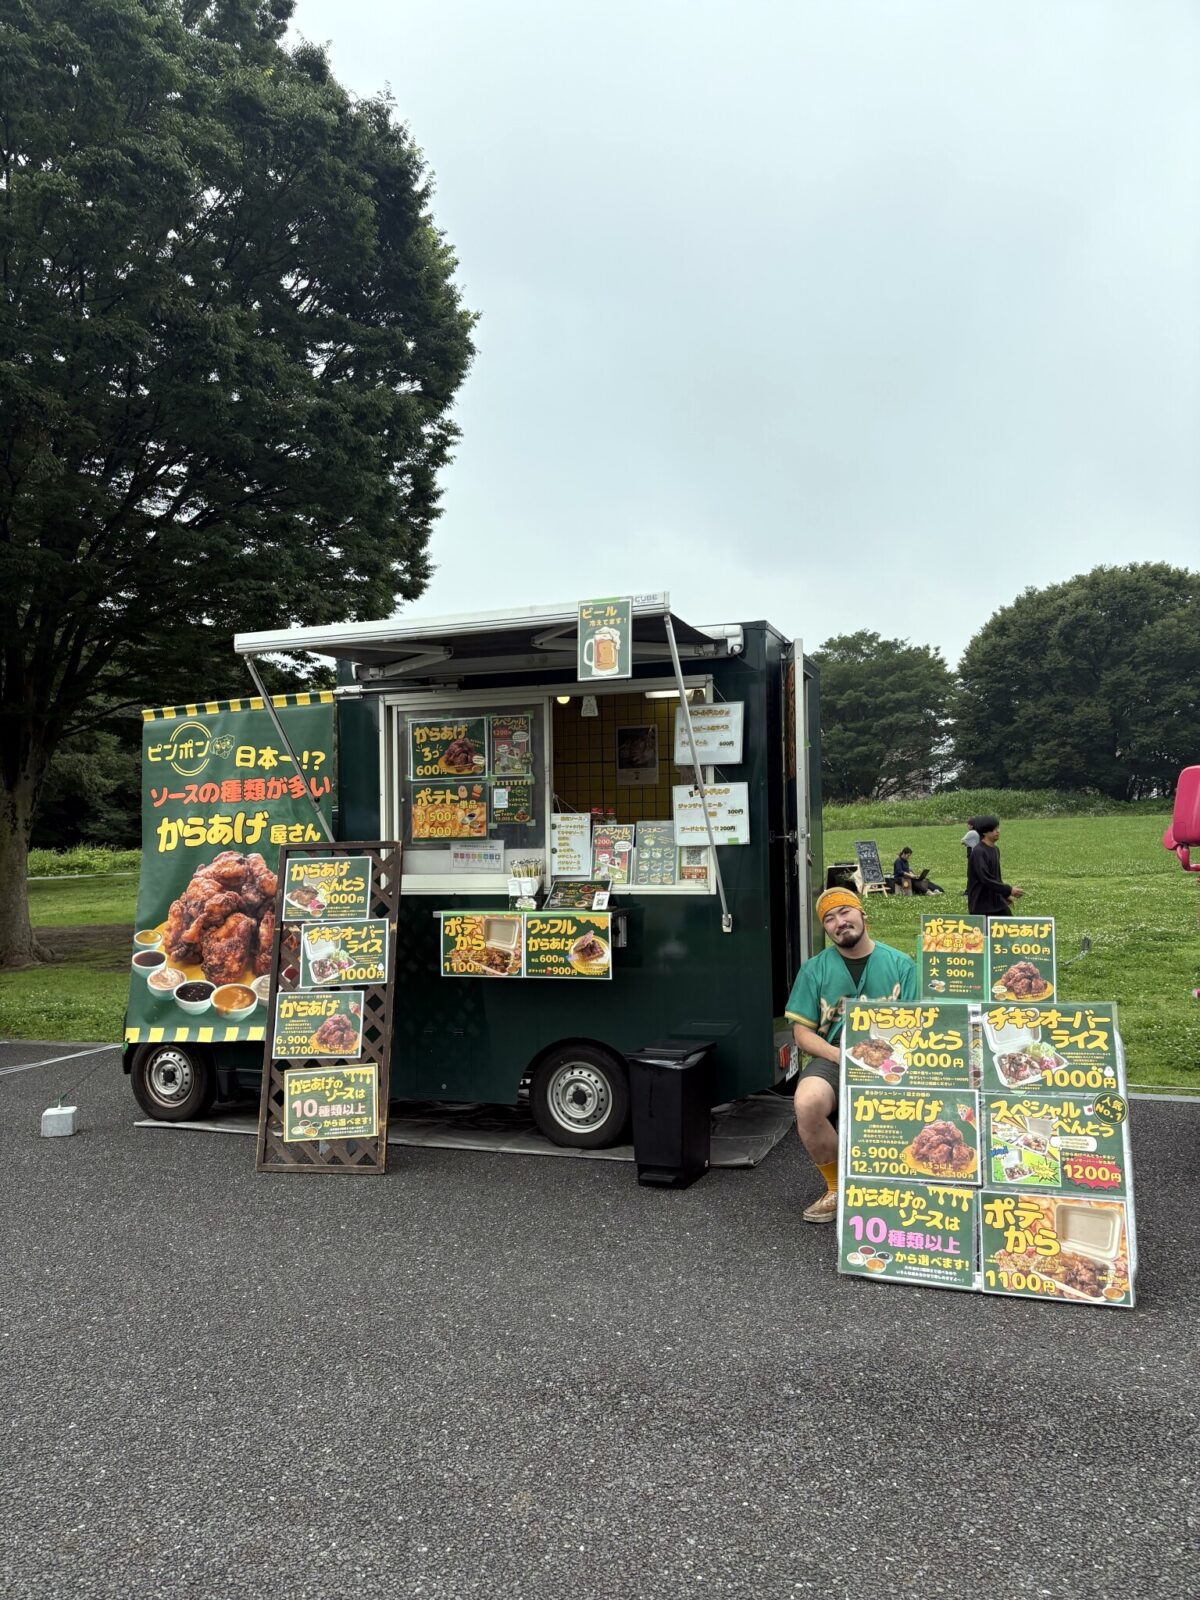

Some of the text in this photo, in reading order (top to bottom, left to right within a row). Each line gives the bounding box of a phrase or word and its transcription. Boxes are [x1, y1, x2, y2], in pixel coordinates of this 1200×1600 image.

[582, 606, 617, 619] ビール
[414, 724, 468, 744] からあげ
[148, 739, 210, 761] ピンポン
[235, 746, 326, 770] 日本一!?
[416, 765, 447, 776] 600円
[150, 774, 331, 807] ソースの種類が多い
[415, 787, 459, 806] ポテト
[459, 800, 478, 810] 単品
[430, 811, 457, 822] 500円
[430, 827, 458, 836] 900円
[594, 827, 631, 836] スペシャル
[290, 861, 351, 881] からあげ
[317, 877, 365, 892] べんとう
[325, 893, 364, 904] 1000円
[307, 925, 385, 944] チキンオーバー
[444, 917, 482, 936] ポテ
[527, 919, 577, 935] ワッフル
[924, 917, 973, 937] ポテト
[991, 922, 1052, 939] からあげ
[346, 939, 382, 953] ライス
[455, 933, 486, 950] から
[527, 937, 575, 952] からあげ
[943, 937, 963, 948] 単品
[1011, 944, 1050, 955] 600円
[444, 962, 482, 973] 1100円
[539, 954, 565, 963] 600円
[929, 956, 974, 966] 小 500円
[339, 968, 385, 981] 1000円
[552, 966, 578, 975] 900円
[929, 968, 974, 978] 大 900円
[280, 1000, 340, 1018] からあげ
[850, 1006, 940, 1031] からあげ
[987, 1006, 1111, 1031] チキンオーバー
[889, 1029, 963, 1050] べんとう
[1051, 1030, 1109, 1051] ライス
[903, 1053, 964, 1068] 1000円
[289, 1076, 343, 1095] からあげの
[1041, 1069, 1117, 1089] 1000円
[325, 1087, 366, 1102] ソースは
[1101, 1096, 1124, 1111] 人気
[292, 1099, 366, 1118] 10種類以上
[853, 1096, 944, 1122] からあげ
[990, 1100, 1081, 1122] スペシャル
[1052, 1118, 1115, 1137] べんとう
[1063, 1164, 1122, 1183] 1200円
[846, 1185, 926, 1210] からあげの
[899, 1209, 961, 1231] ソースは
[984, 1197, 1044, 1228] ポテ
[849, 1215, 961, 1254] 10種類以上
[1004, 1225, 1061, 1256] から
[895, 1252, 970, 1271] から選べます!
[986, 1269, 1056, 1293] 1100円
